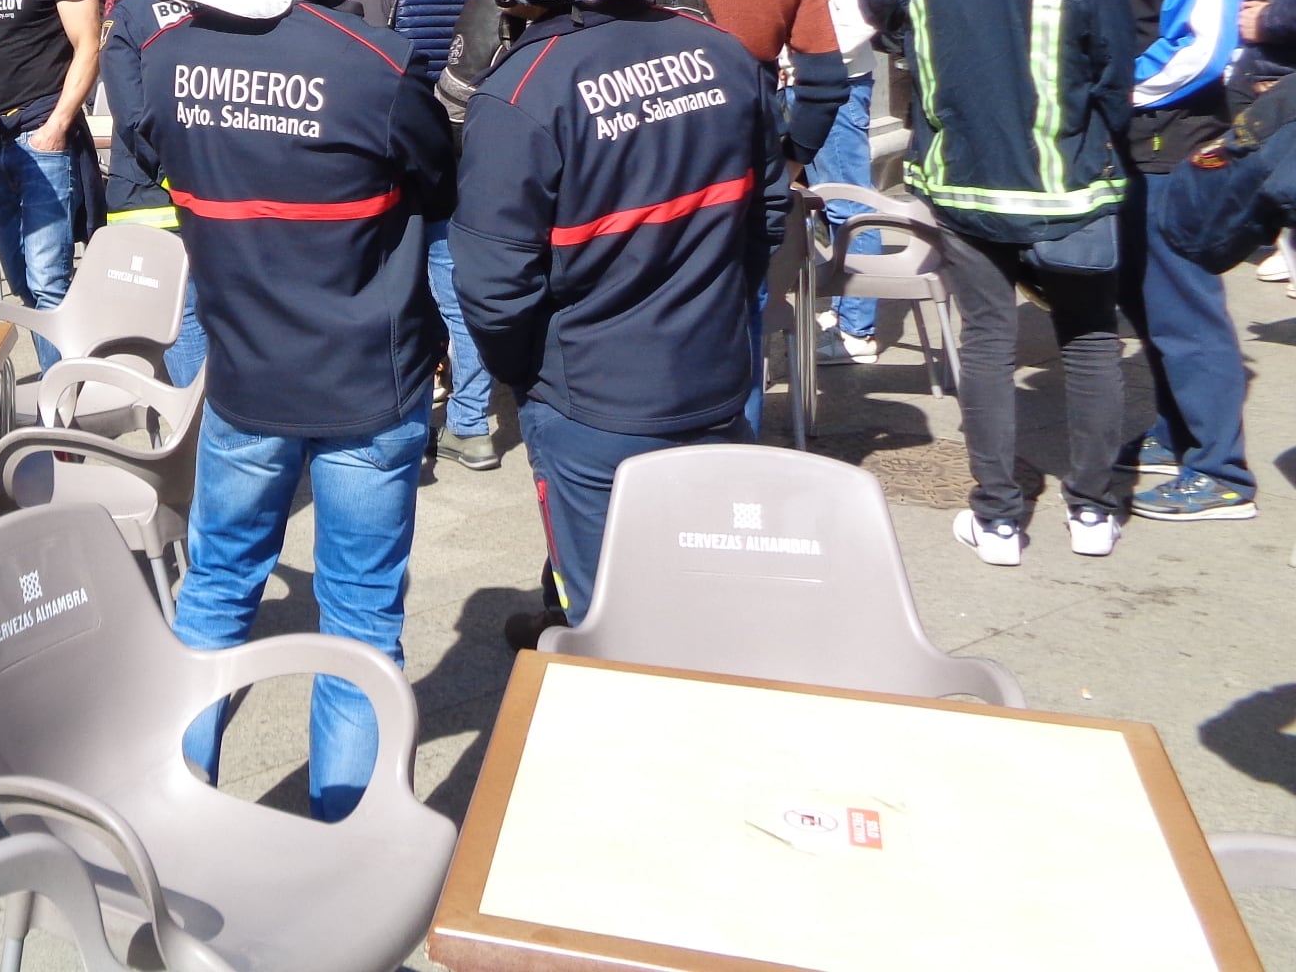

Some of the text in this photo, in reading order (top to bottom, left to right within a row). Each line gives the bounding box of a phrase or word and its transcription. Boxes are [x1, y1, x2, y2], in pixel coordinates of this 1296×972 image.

[174, 64, 325, 111] BOMBEROS
[577, 49, 715, 114] BOMBEROS
[176, 101, 320, 138] Ayto. Salamanca
[596, 88, 726, 141] Ayto. Salamanca
[678, 532, 822, 556] CERVEZAS ALHAMBRA
[35, 587, 88, 624] ALHAMBRA
